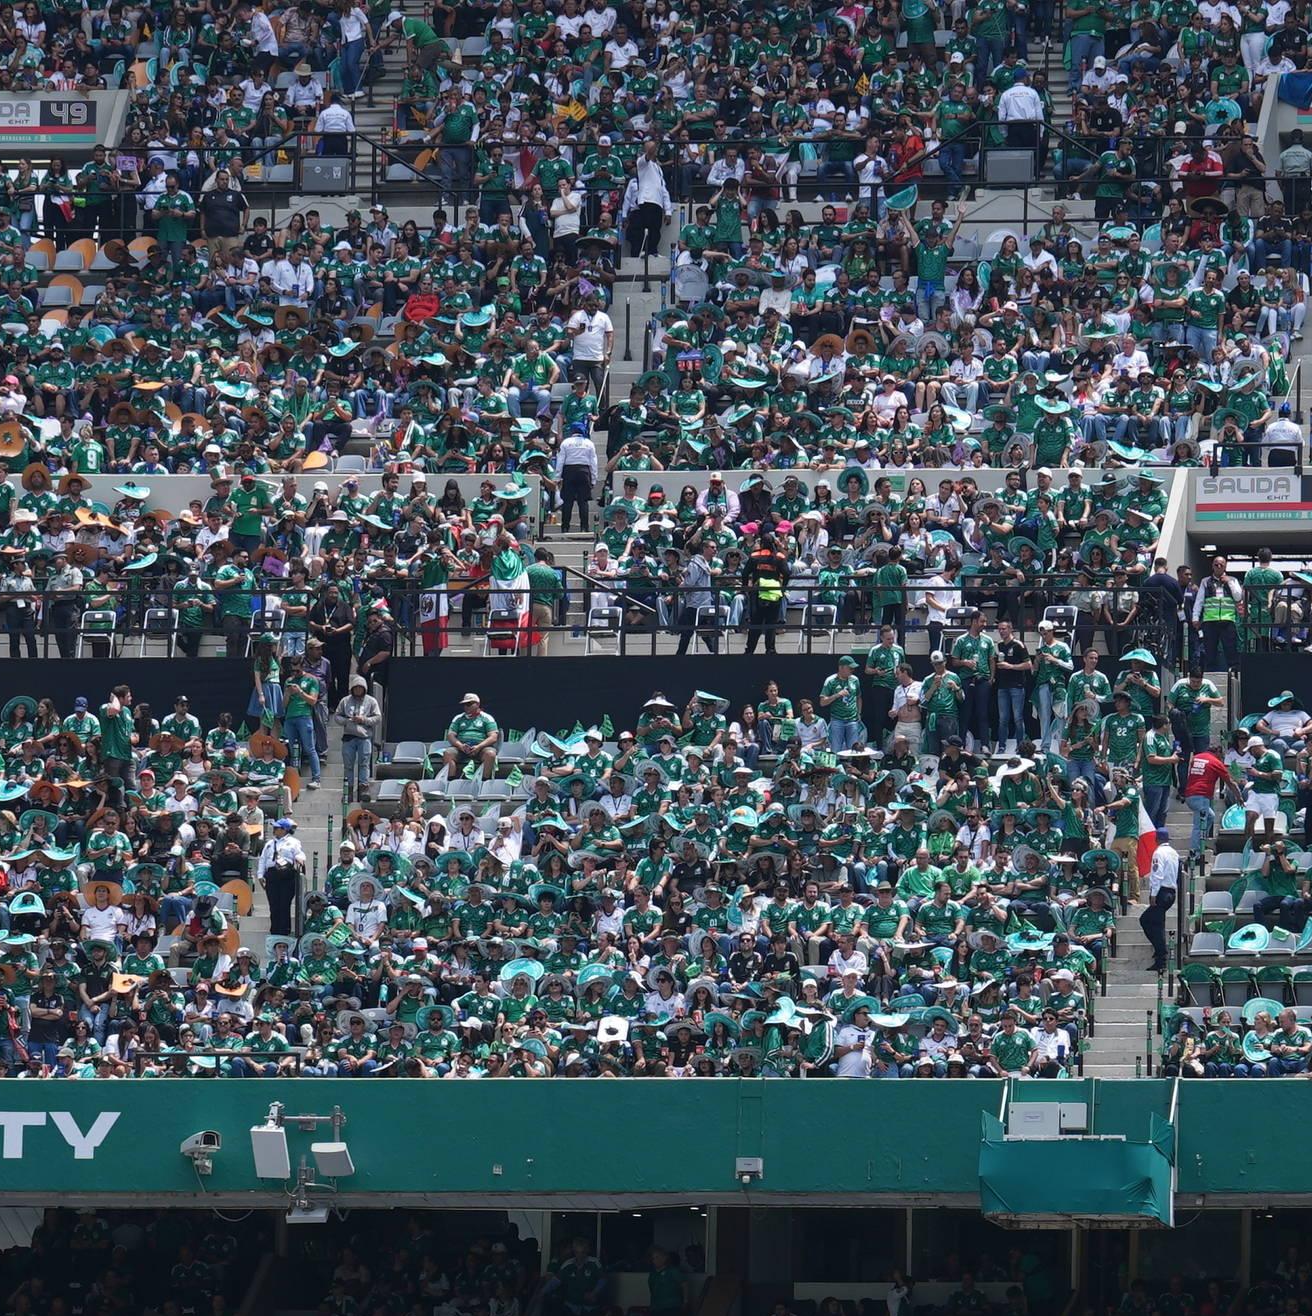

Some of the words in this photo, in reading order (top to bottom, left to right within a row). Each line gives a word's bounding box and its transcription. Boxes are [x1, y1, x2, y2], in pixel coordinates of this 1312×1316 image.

[50, 102, 88, 125] 49
[87, 450, 98, 470] 9
[1202, 477, 1291, 494] SALIDA
[1116, 727, 1128, 737] 22
